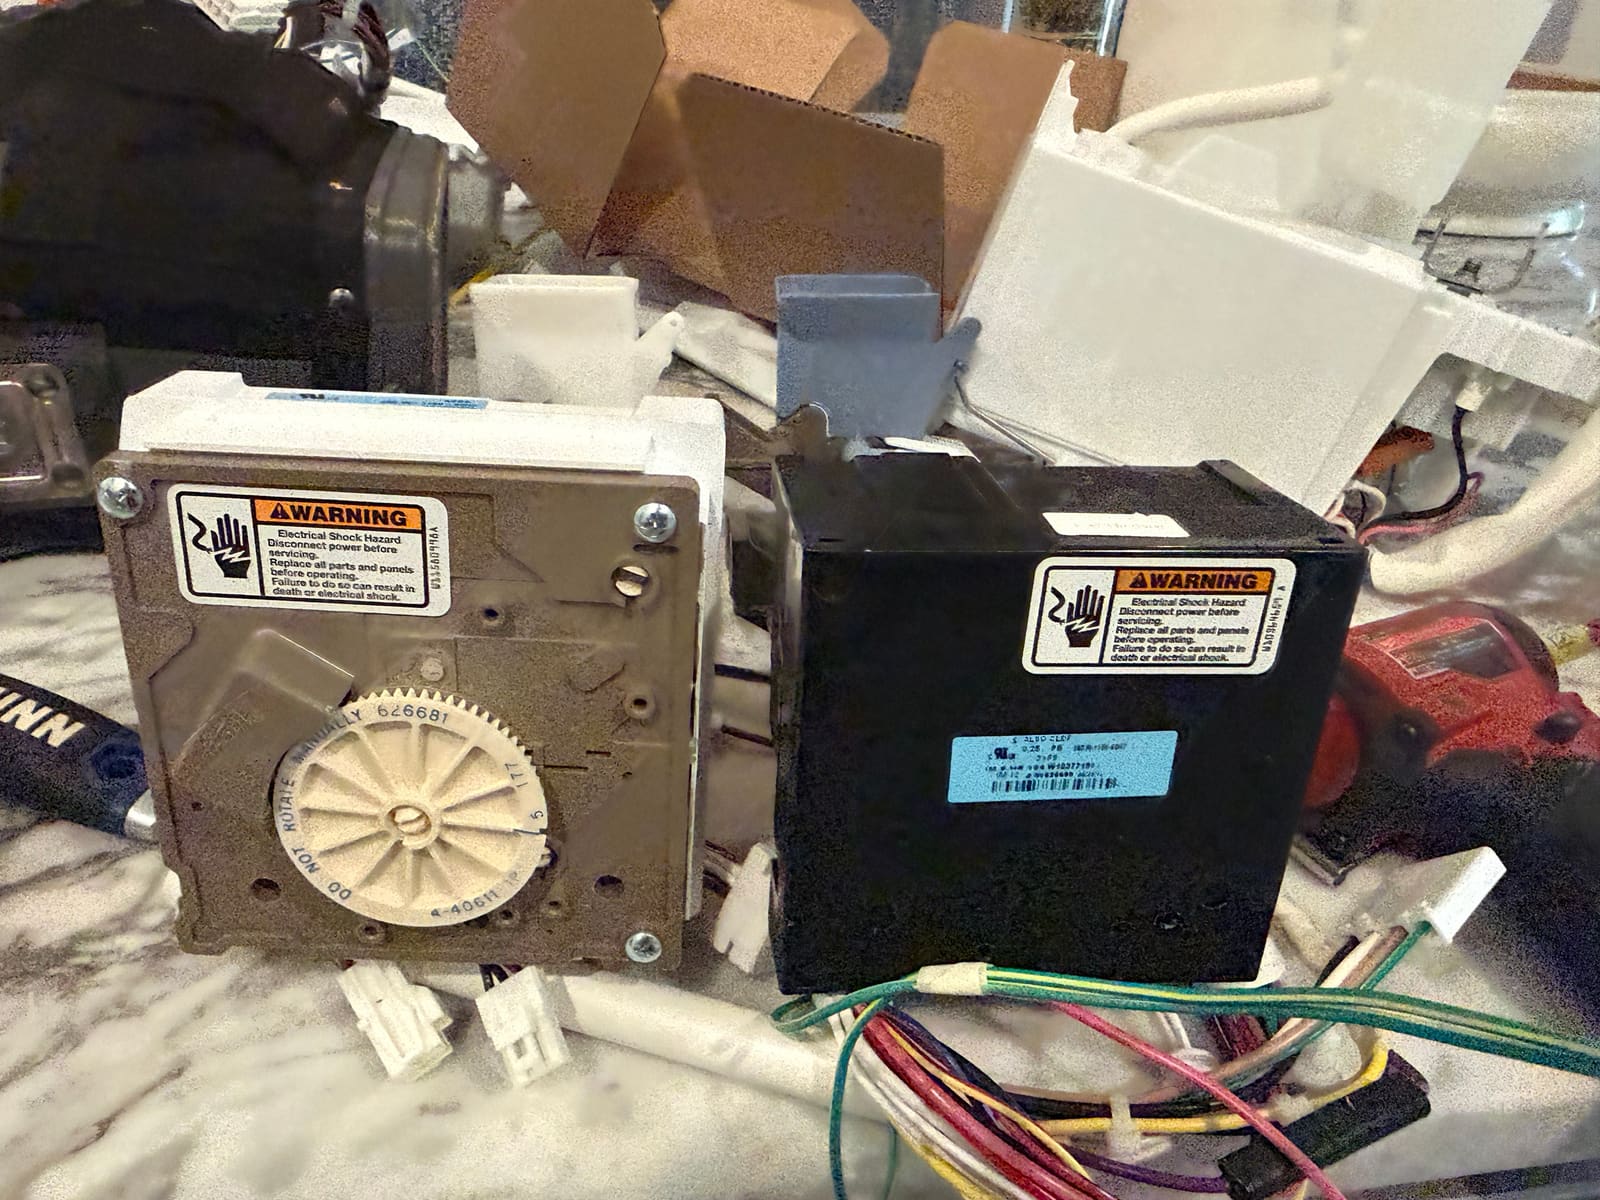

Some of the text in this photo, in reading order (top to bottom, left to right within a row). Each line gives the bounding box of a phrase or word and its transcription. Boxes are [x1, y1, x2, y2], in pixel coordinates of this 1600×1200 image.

[289, 505, 407, 527] WARNING
[278, 529, 401, 544] Electrical Shock Hazard
[268, 539, 398, 554] Disconnect power before
[269, 549, 320, 560] servicing.
[270, 558, 415, 574] Replace all parts and panels
[271, 568, 360, 581] before operating.
[1150, 572, 1258, 590] WARNING
[272, 578, 415, 593] Failure to do so can result in
[273, 587, 401, 601] death or electrical shock.
[1131, 598, 1246, 607] Electrical Shock Hazard
[1119, 607, 1240, 617] Disconnect power before
[1117, 616, 1164, 626] servicing.
[1115, 625, 1250, 636] Replace all parts and panels
[1114, 635, 1196, 645] before operating.
[1112, 644, 1148, 653] Failure
[1149, 645, 1159, 653] to
[1160, 644, 1172, 653] do
[1174, 645, 1186, 653] so
[1207, 644, 1233, 653] result
[1235, 644, 1246, 653] in
[1110, 653, 1229, 662] death or electrical shock.
[283, 779, 297, 833] ROTATE
[291, 846, 321, 875] NOT
[328, 881, 353, 901] DO
